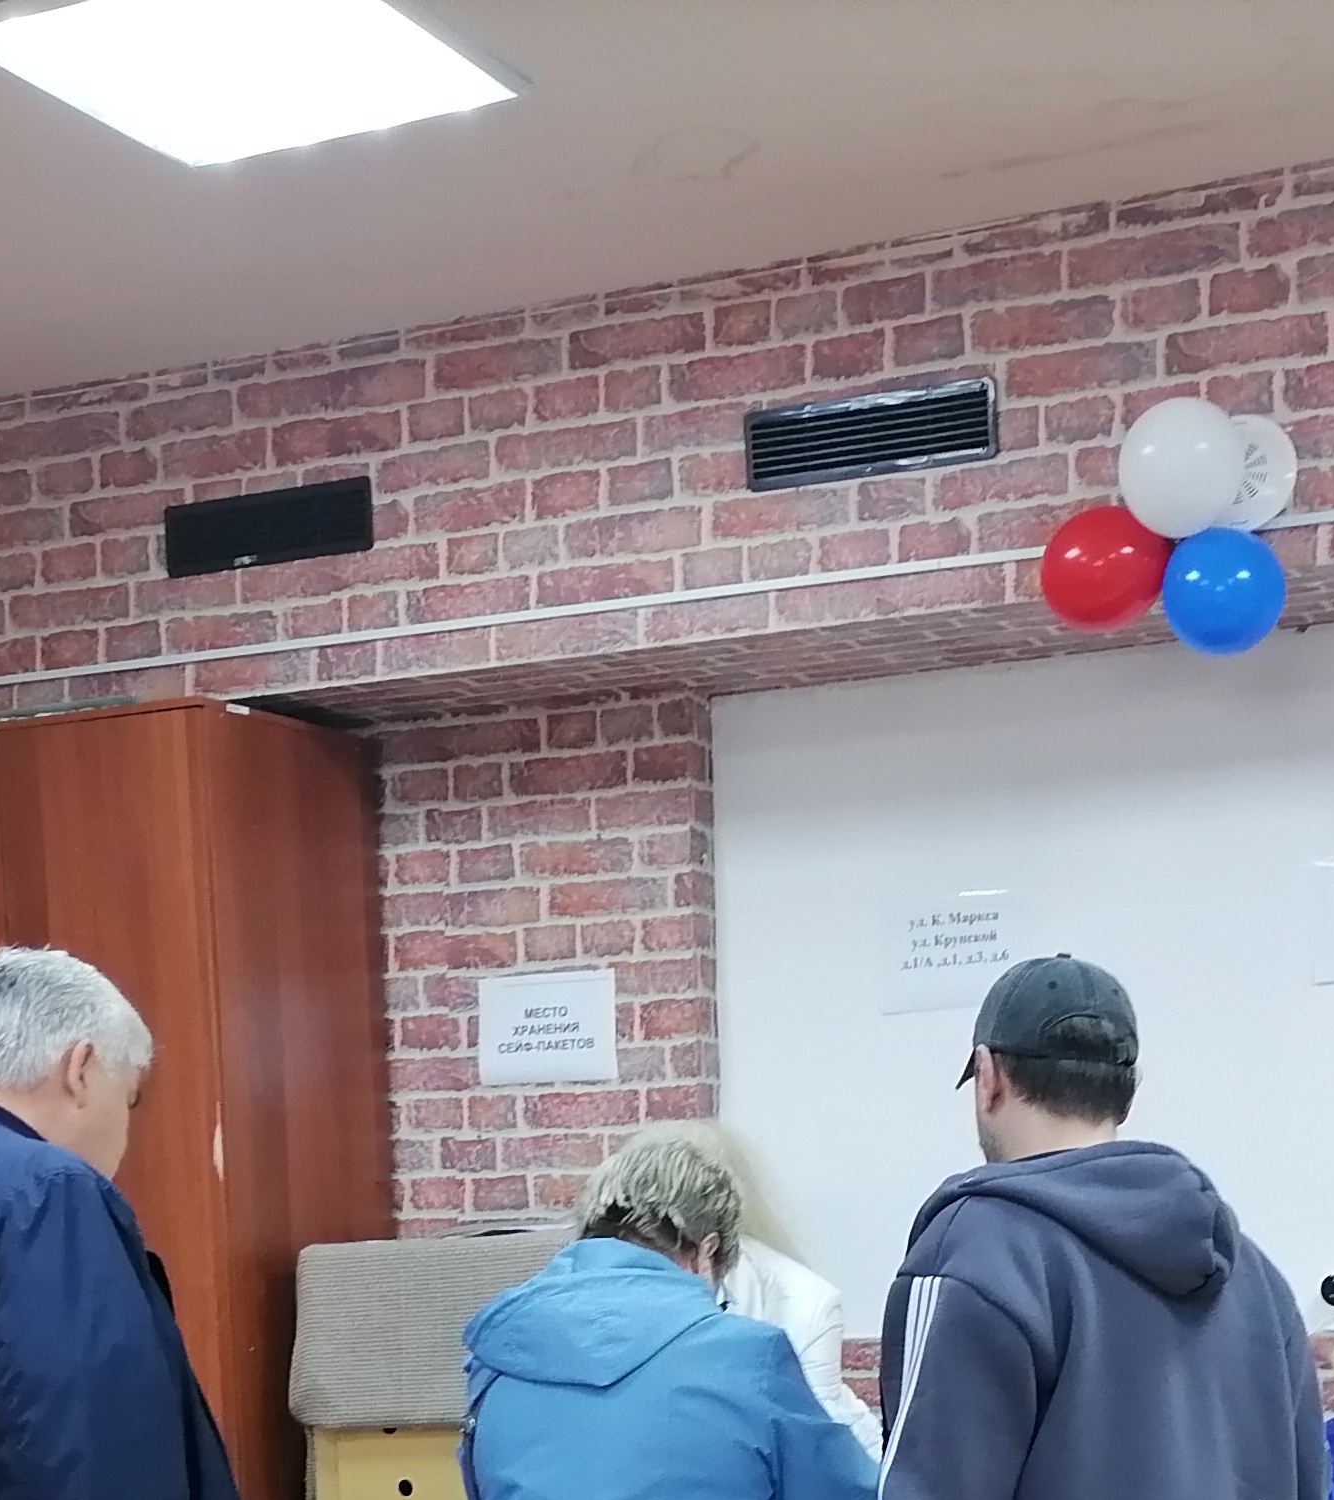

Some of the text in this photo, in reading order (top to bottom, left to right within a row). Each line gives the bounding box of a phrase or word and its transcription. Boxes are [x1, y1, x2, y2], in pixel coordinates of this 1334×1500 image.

[934, 929, 997, 948] Крупской
[524, 1006, 568, 1019] МЕСТО
[512, 1021, 580, 1037] ХРАНЕНИЯ
[498, 1037, 595, 1054] СЕЙФ-ПАКЕТОВ
